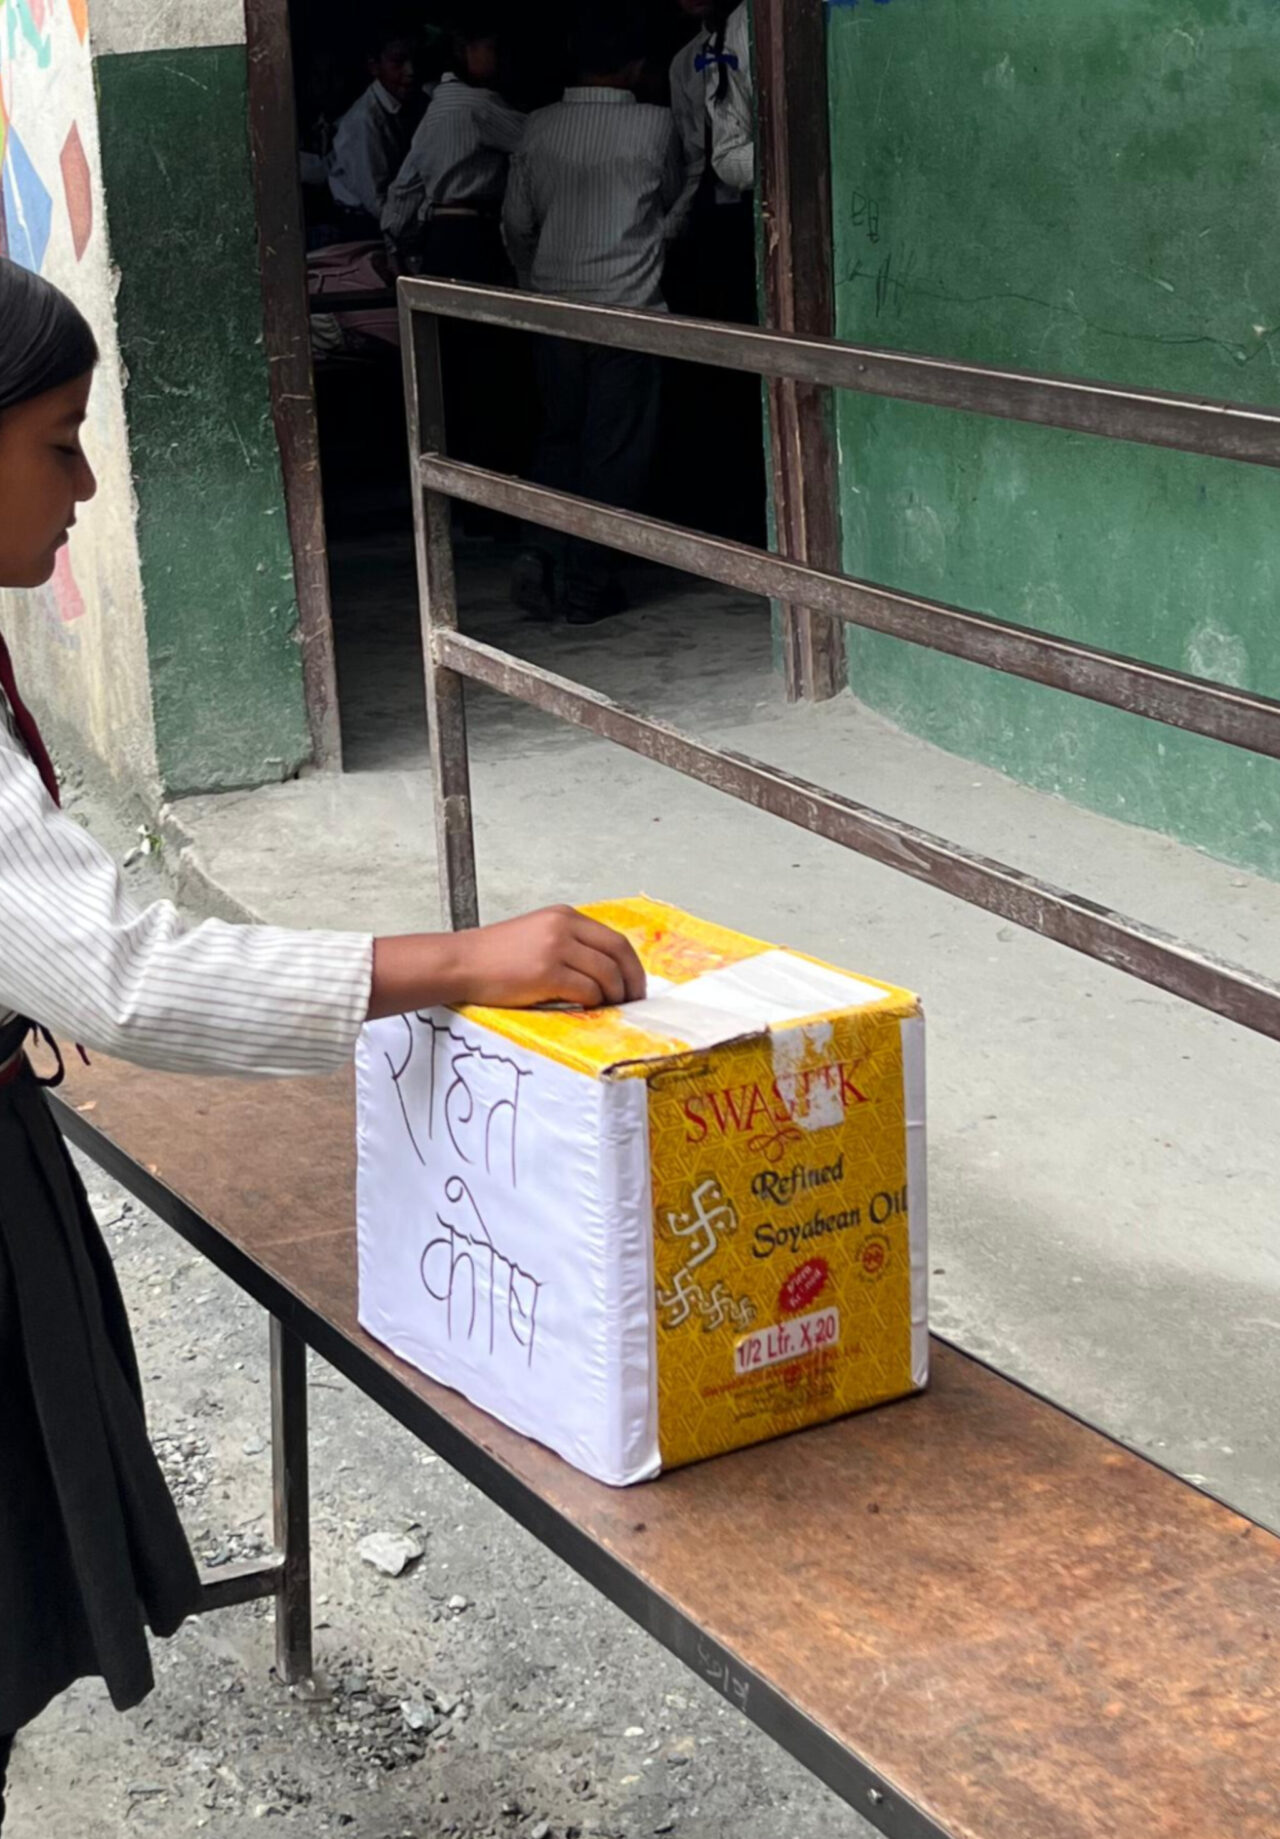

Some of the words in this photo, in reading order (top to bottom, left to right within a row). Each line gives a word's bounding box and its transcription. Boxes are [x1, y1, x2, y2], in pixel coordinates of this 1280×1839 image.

[751, 1152, 844, 1206] Refined
[752, 1209, 861, 1258] Soyabean
[869, 1185, 908, 1224] Oil
[737, 1339, 761, 1367] 1/2
[815, 1314, 835, 1343] 20
